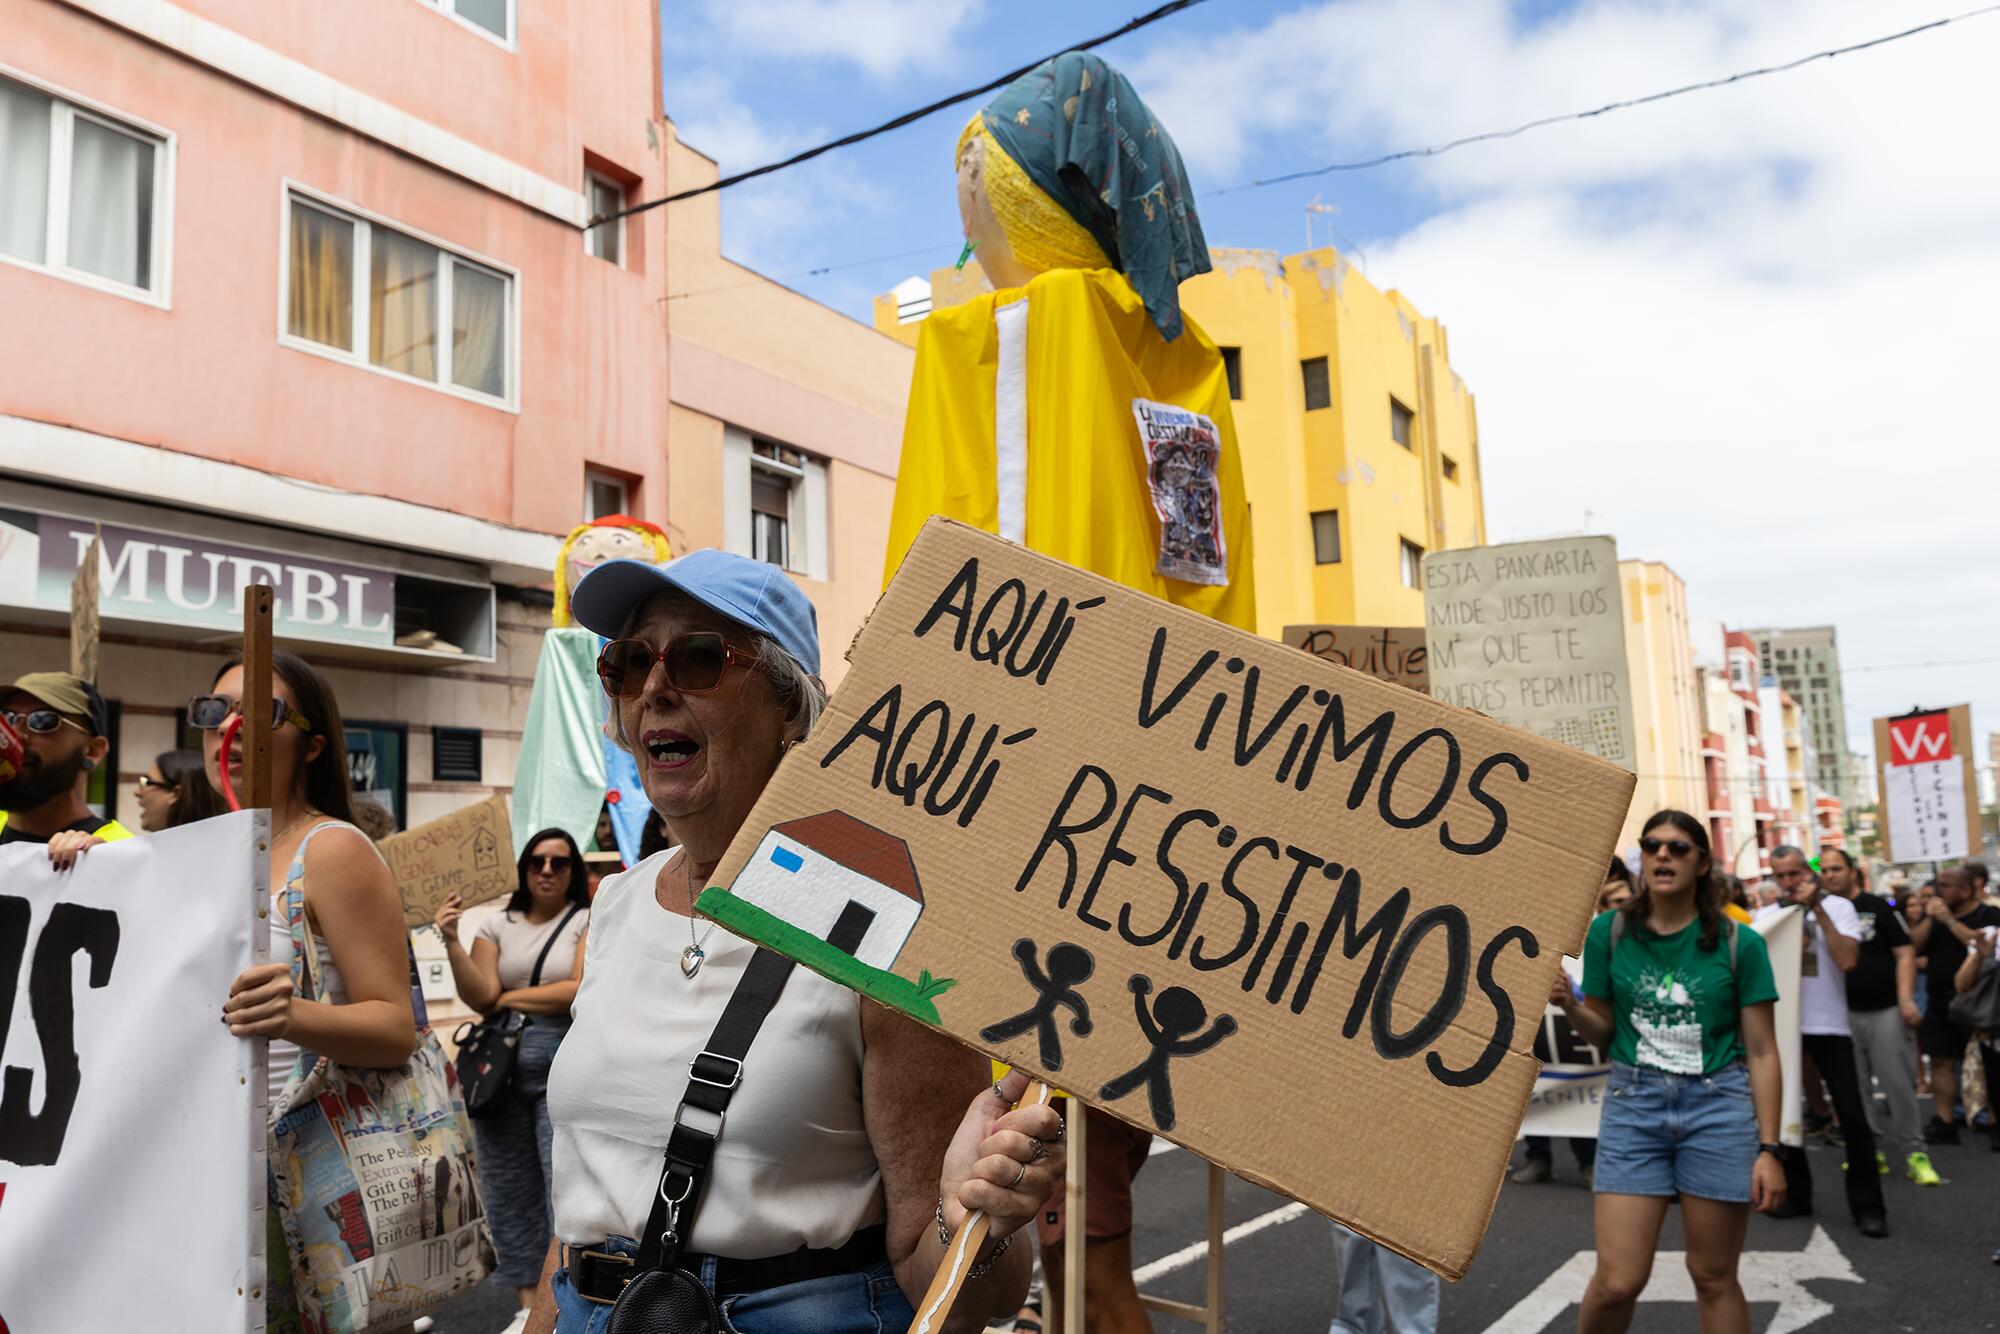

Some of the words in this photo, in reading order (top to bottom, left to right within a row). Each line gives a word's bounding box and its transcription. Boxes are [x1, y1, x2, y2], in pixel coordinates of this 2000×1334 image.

[69, 531, 390, 634] MUEBL
[1426, 561, 1480, 589] ESTA
[1495, 549, 1597, 580] PANCARTA
[914, 557, 1106, 685] AQUÍ
[1431, 598, 1485, 627] MIDE
[1497, 592, 1555, 622] JUSTO
[1568, 587, 1608, 617] LOS
[1482, 631, 1531, 668] QUE
[1551, 628, 1583, 660] TE
[1434, 679, 1506, 711] PUEDES
[1519, 671, 1621, 708] PERMITIR
[820, 684, 1038, 828] AQUÍ
[356, 1152, 384, 1168] The
[366, 1180, 396, 1199] Gift
[370, 1197, 399, 1213] The
[376, 1226, 402, 1246] Gift
